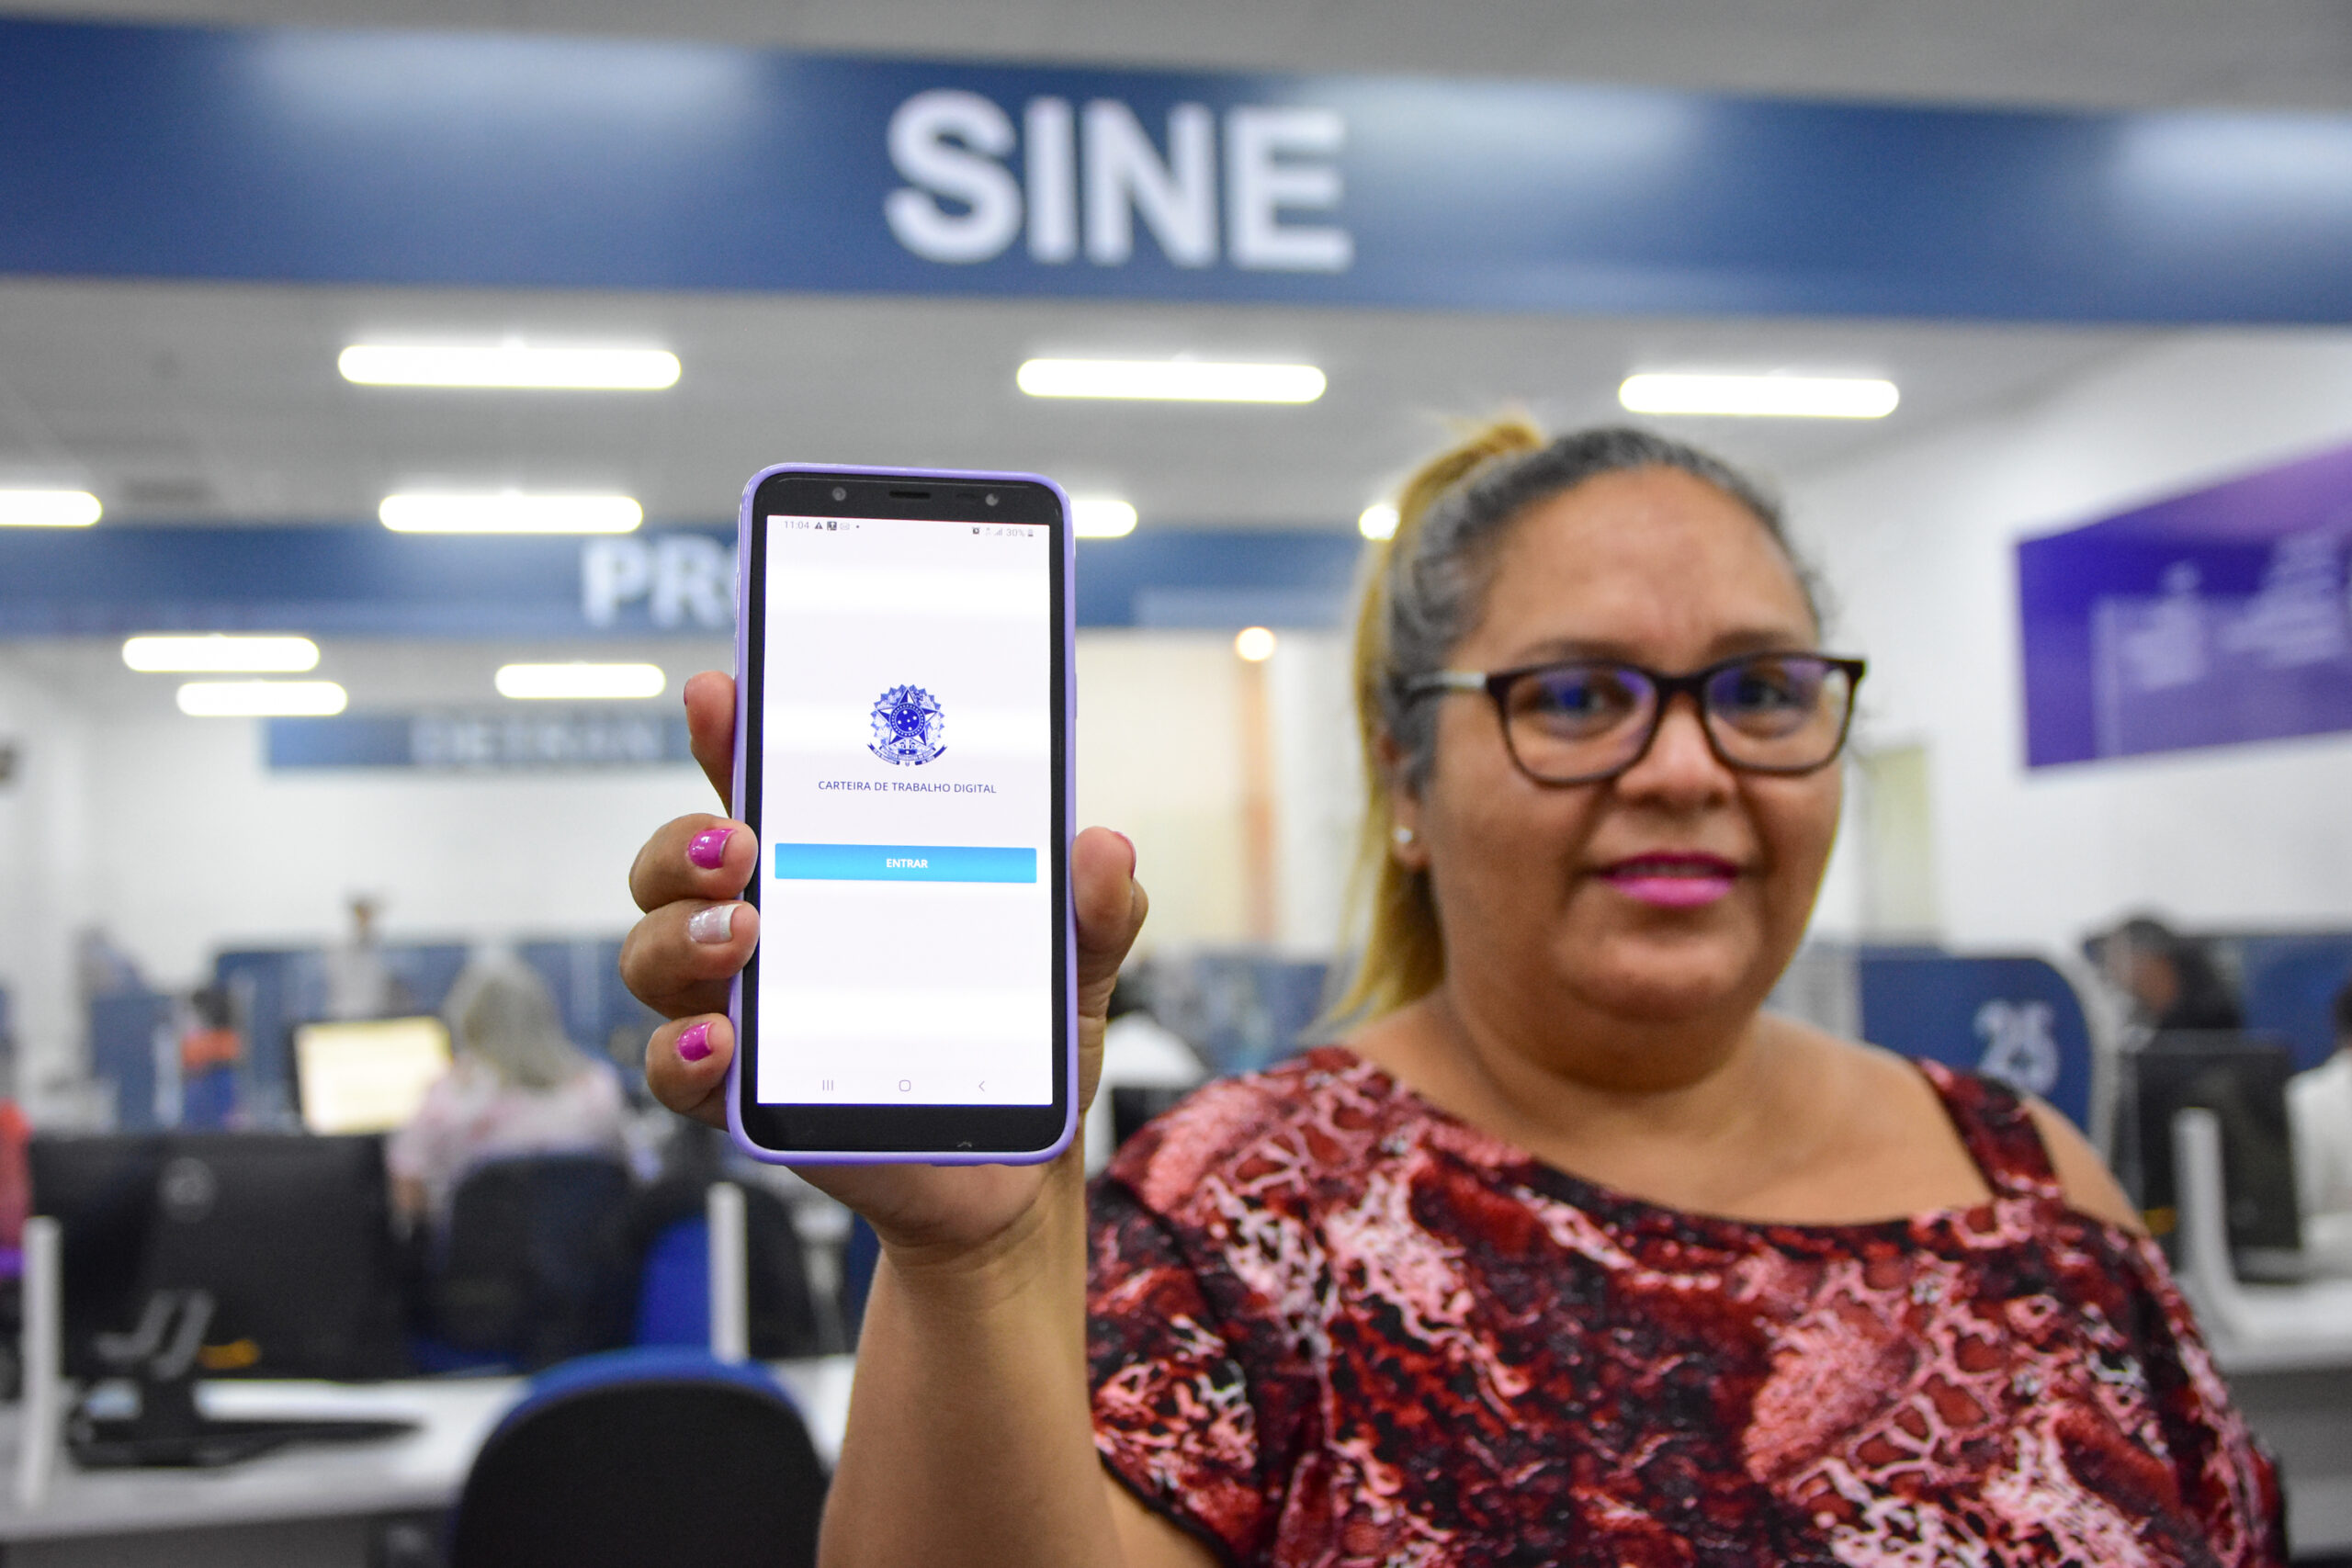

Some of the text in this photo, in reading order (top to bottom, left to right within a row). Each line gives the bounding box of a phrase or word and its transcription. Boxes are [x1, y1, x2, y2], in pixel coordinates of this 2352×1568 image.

[888, 90, 1354, 272] SINE
[785, 521, 809, 529] 11:04
[582, 533, 739, 628] PR
[818, 781, 997, 794] CARTEIRA DE TRABALHO DIGITAL
[886, 858, 928, 868] ENTRAR
